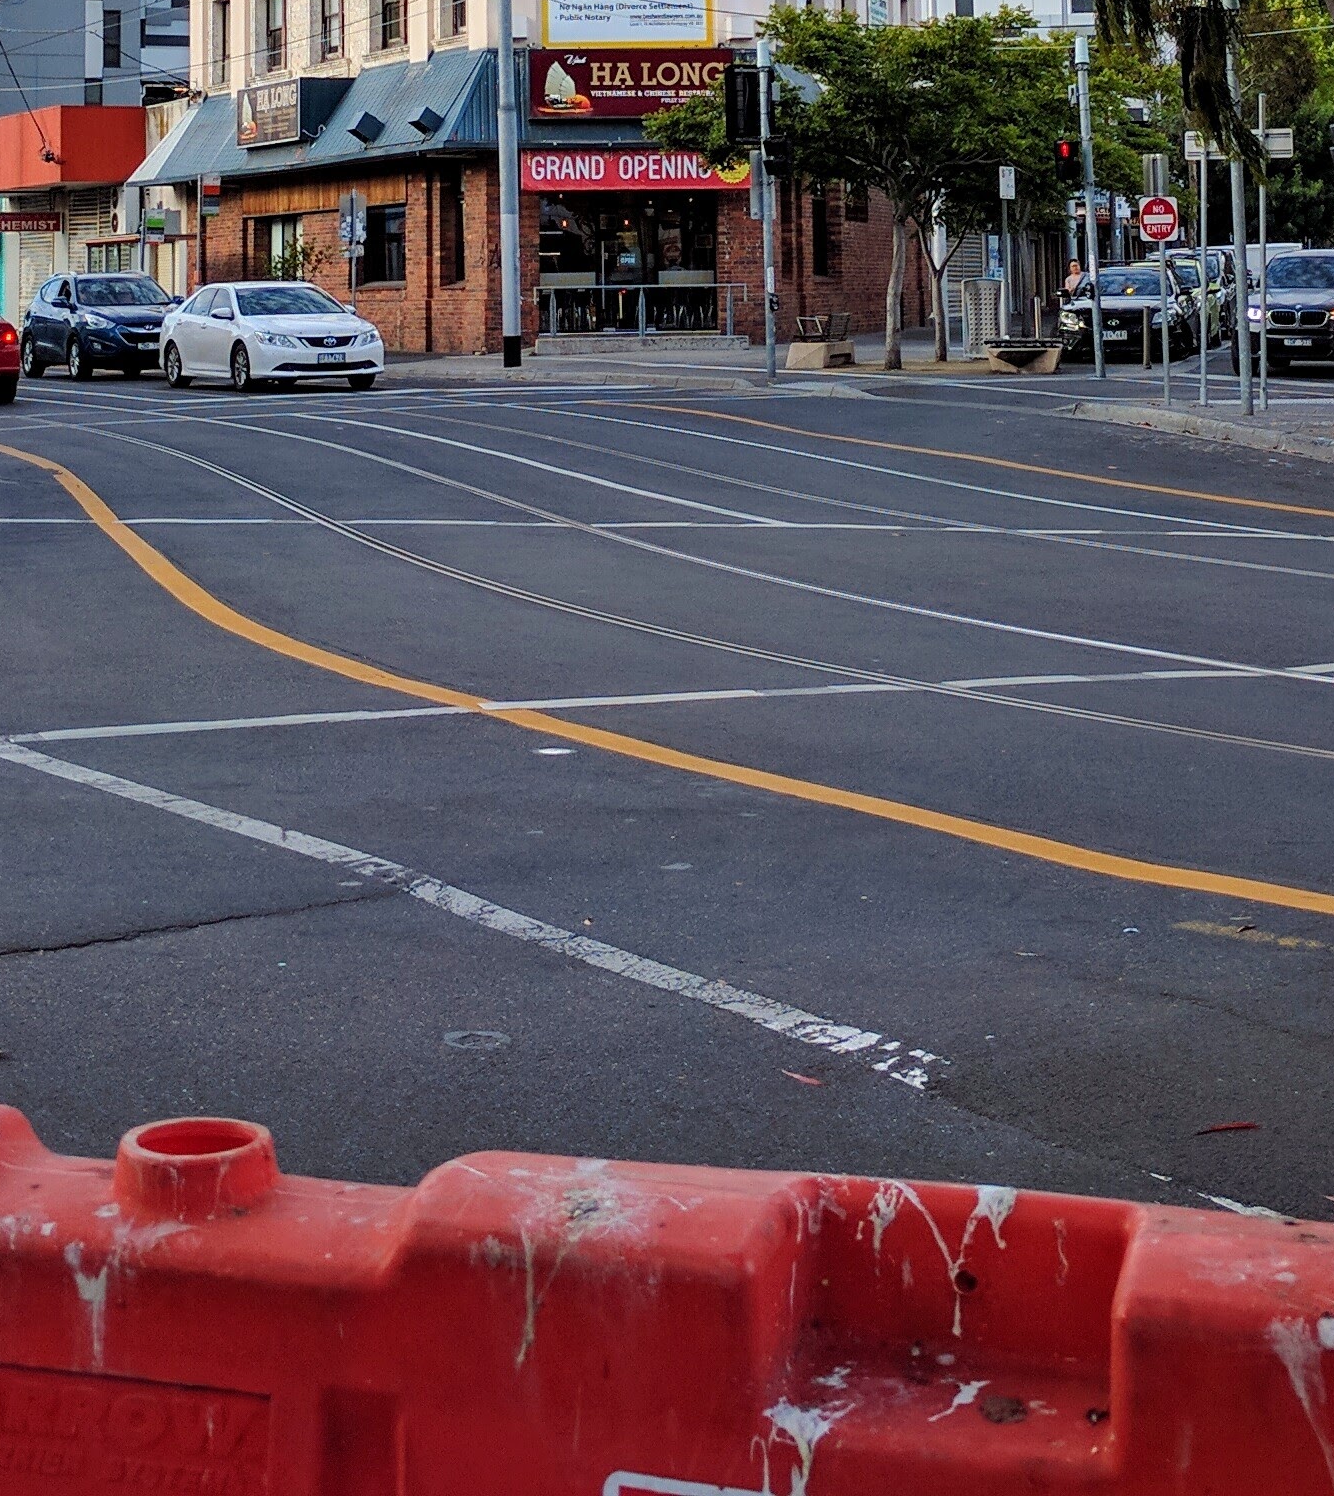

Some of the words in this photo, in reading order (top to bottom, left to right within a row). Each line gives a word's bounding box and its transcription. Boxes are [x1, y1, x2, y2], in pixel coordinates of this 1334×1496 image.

[559, 14, 583, 22] Public
[585, 14, 611, 23] Notary
[590, 62, 634, 89] HẠ
[641, 61, 726, 87] LONG
[271, 82, 298, 110] LONG
[531, 155, 605, 181] GRAND
[1152, 205, 1165, 214] NO
[1147, 225, 1173, 234] ENTRY
